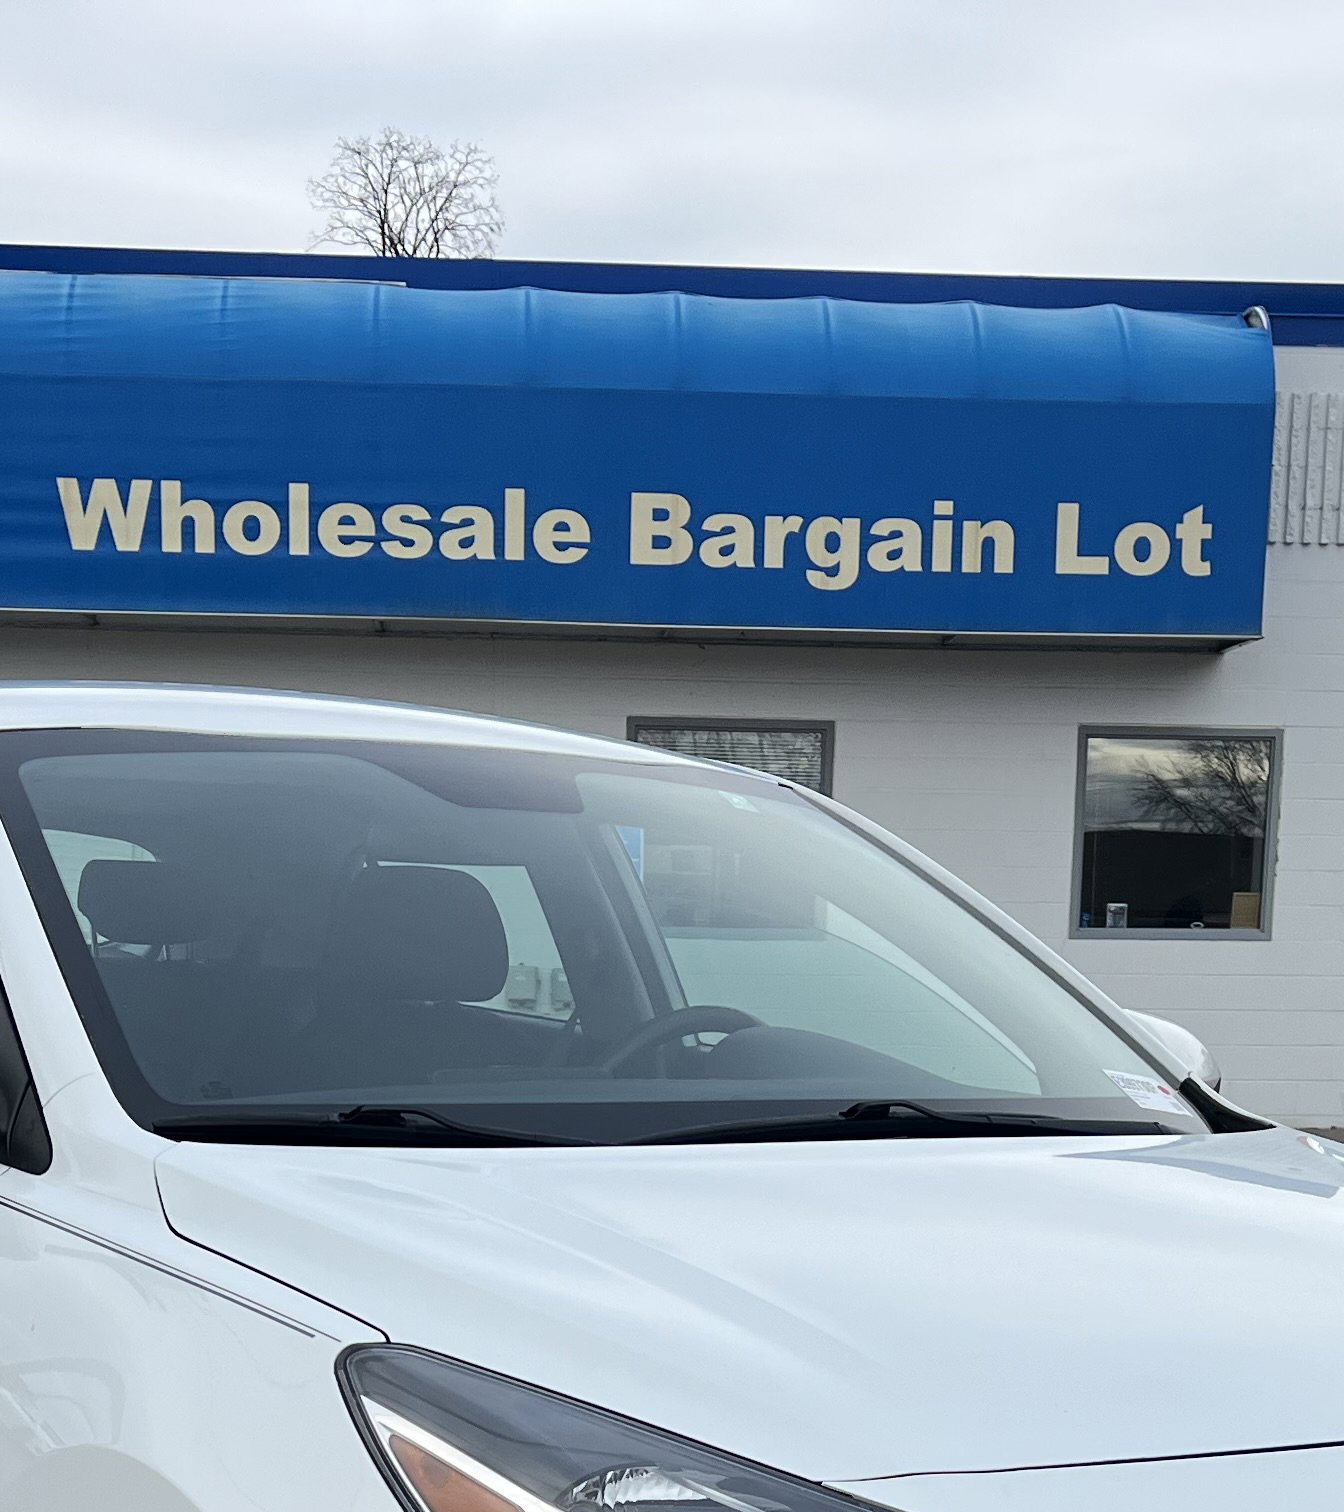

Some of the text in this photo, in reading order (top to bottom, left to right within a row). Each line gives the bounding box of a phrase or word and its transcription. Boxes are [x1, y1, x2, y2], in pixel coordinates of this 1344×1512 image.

[56, 476, 1213, 592] Wholesale Bargain Lot
